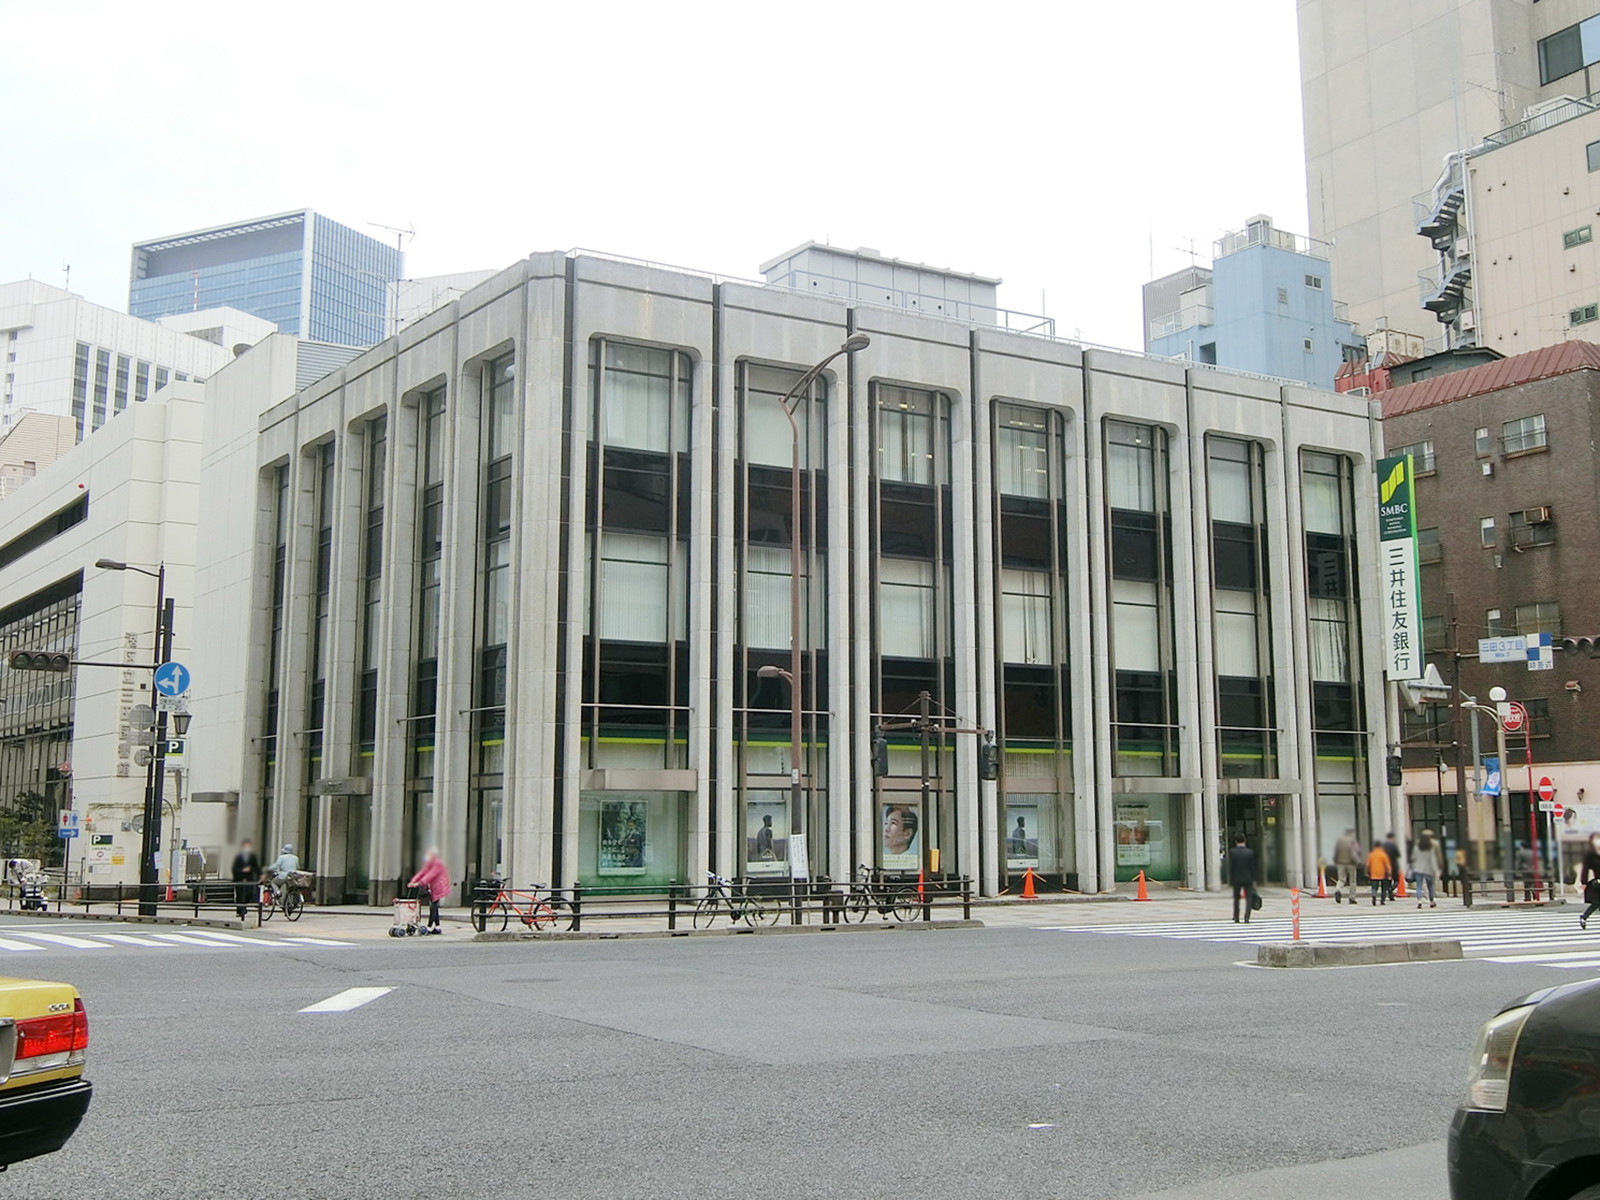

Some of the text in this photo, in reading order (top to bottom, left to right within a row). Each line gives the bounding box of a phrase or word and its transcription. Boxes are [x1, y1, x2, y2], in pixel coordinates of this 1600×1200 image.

[1380, 503, 1408, 517] SMBC
[1388, 547, 1410, 672] 三井住友銀行
[168, 741, 179, 753] P
[93, 835, 102, 844] P
